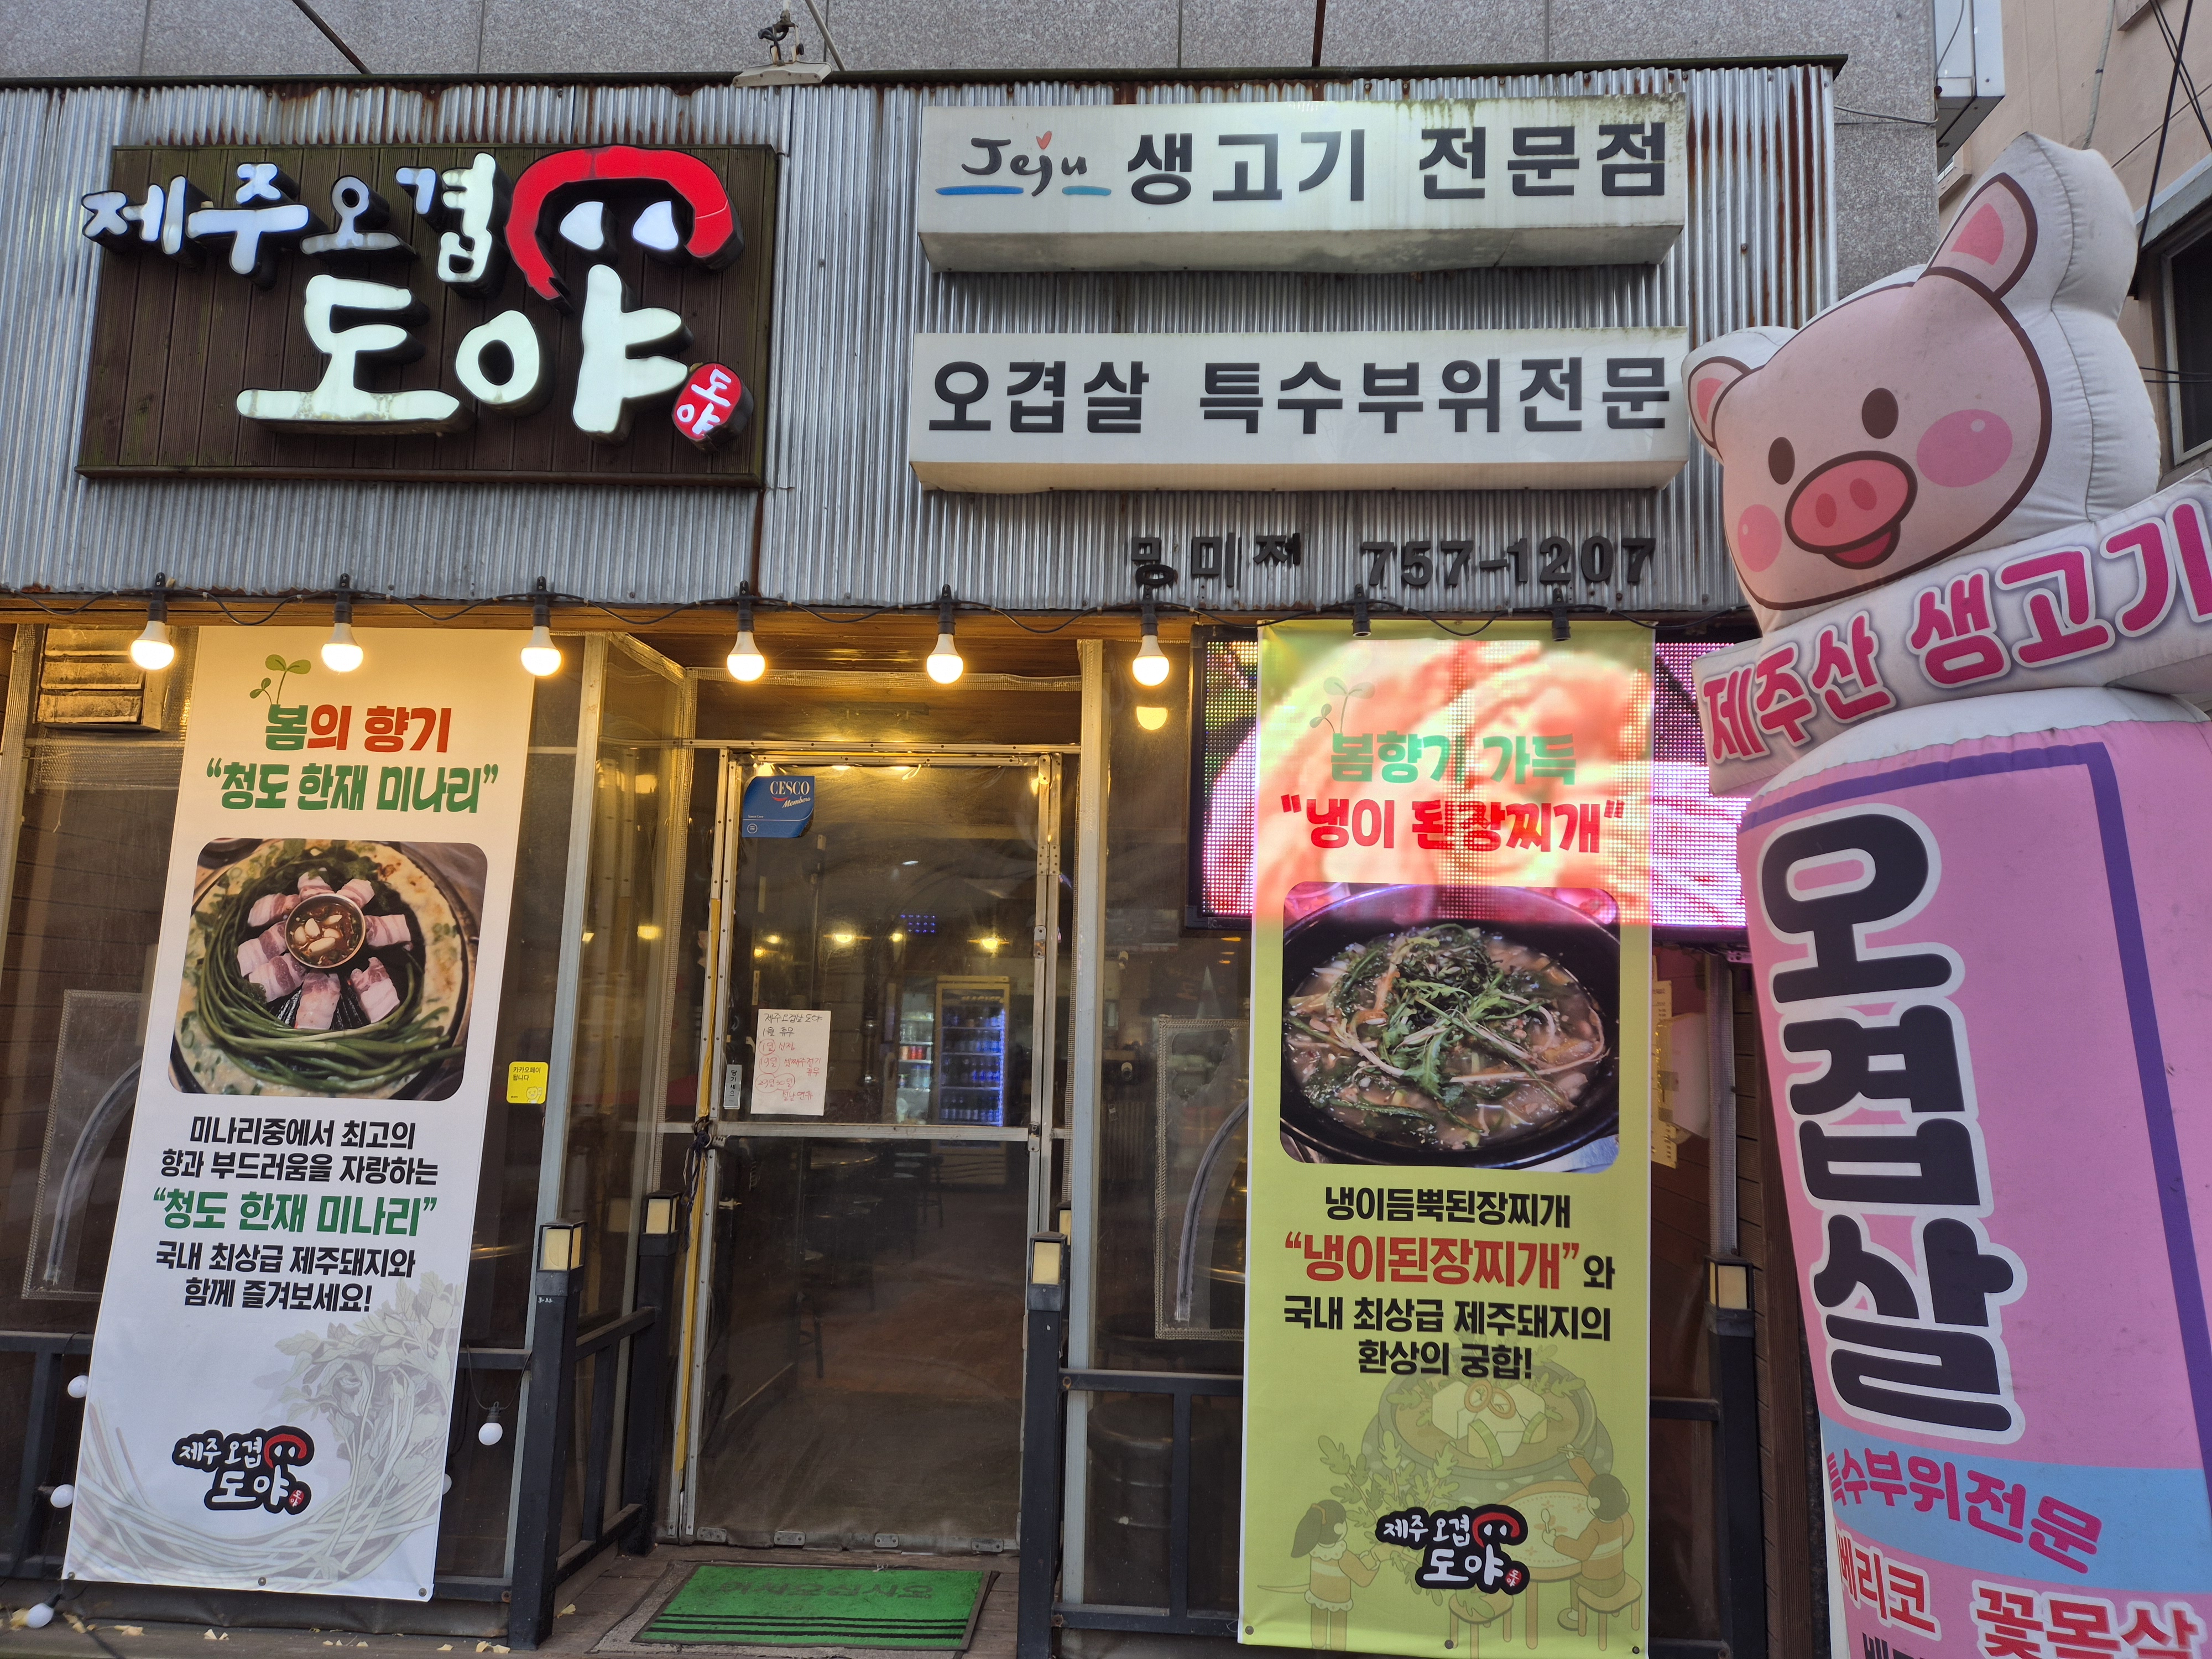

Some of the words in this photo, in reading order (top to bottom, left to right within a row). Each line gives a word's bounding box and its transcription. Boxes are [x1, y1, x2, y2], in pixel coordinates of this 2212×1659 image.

[962, 131, 1087, 197] Jeju
[1128, 128, 1365, 205] 생고기
[1418, 122, 1666, 200] 전문점
[236, 264, 688, 434] 도야
[928, 360, 1150, 434] 오겹살
[1199, 357, 1671, 434] 특수부위전문
[1362, 536, 1656, 587] 757-1207
[1703, 614, 1890, 761] 제주산
[1911, 502, 2212, 685] 생고기
[265, 703, 352, 751] 봄의
[364, 706, 451, 753] 향기
[1483, 732, 1577, 785] 가득
[298, 763, 368, 811] 한재
[770, 781, 810, 795] CESCO
[781, 796, 811, 808] Members
[763, 1026, 775, 1037] 1월
[779, 1027, 795, 1037] 휴무
[805, 1014, 823, 1022] 도야
[760, 1057, 778, 1068] 19일
[762, 1042, 774, 1051] 1일
[190, 1117, 335, 1147] 미나리중에서
[341, 1120, 416, 1150] 최고의
[1761, 812, 2015, 1432] 오겹살
[160, 1148, 204, 1178] 향과
[210, 1151, 333, 1182] 부드러움을
[339, 1155, 439, 1185] 자랑하는
[239, 1191, 308, 1232] 한재
[1325, 1187, 1571, 1228] 냉이듬뿍된장찌개
[156, 1240, 203, 1270] 국내
[208, 1243, 283, 1273] 최상급
[289, 1246, 416, 1278] 제주돼지와
[184, 1276, 236, 1308] 함께
[242, 1280, 372, 1312] 즐겨보세요!
[1284, 1295, 1344, 1330] 국내
[1353, 1296, 1444, 1333] 최상급
[1453, 1300, 1611, 1342] 제주돼지의
[1358, 1338, 1449, 1376] 환상의
[1459, 1342, 1532, 1380] 궁합!
[211, 1464, 290, 1506] 도야
[1827, 1447, 2102, 1574] 특수부위전문
[1423, 1543, 1504, 1585] 도야
[1835, 1524, 1936, 1634] 베리코
